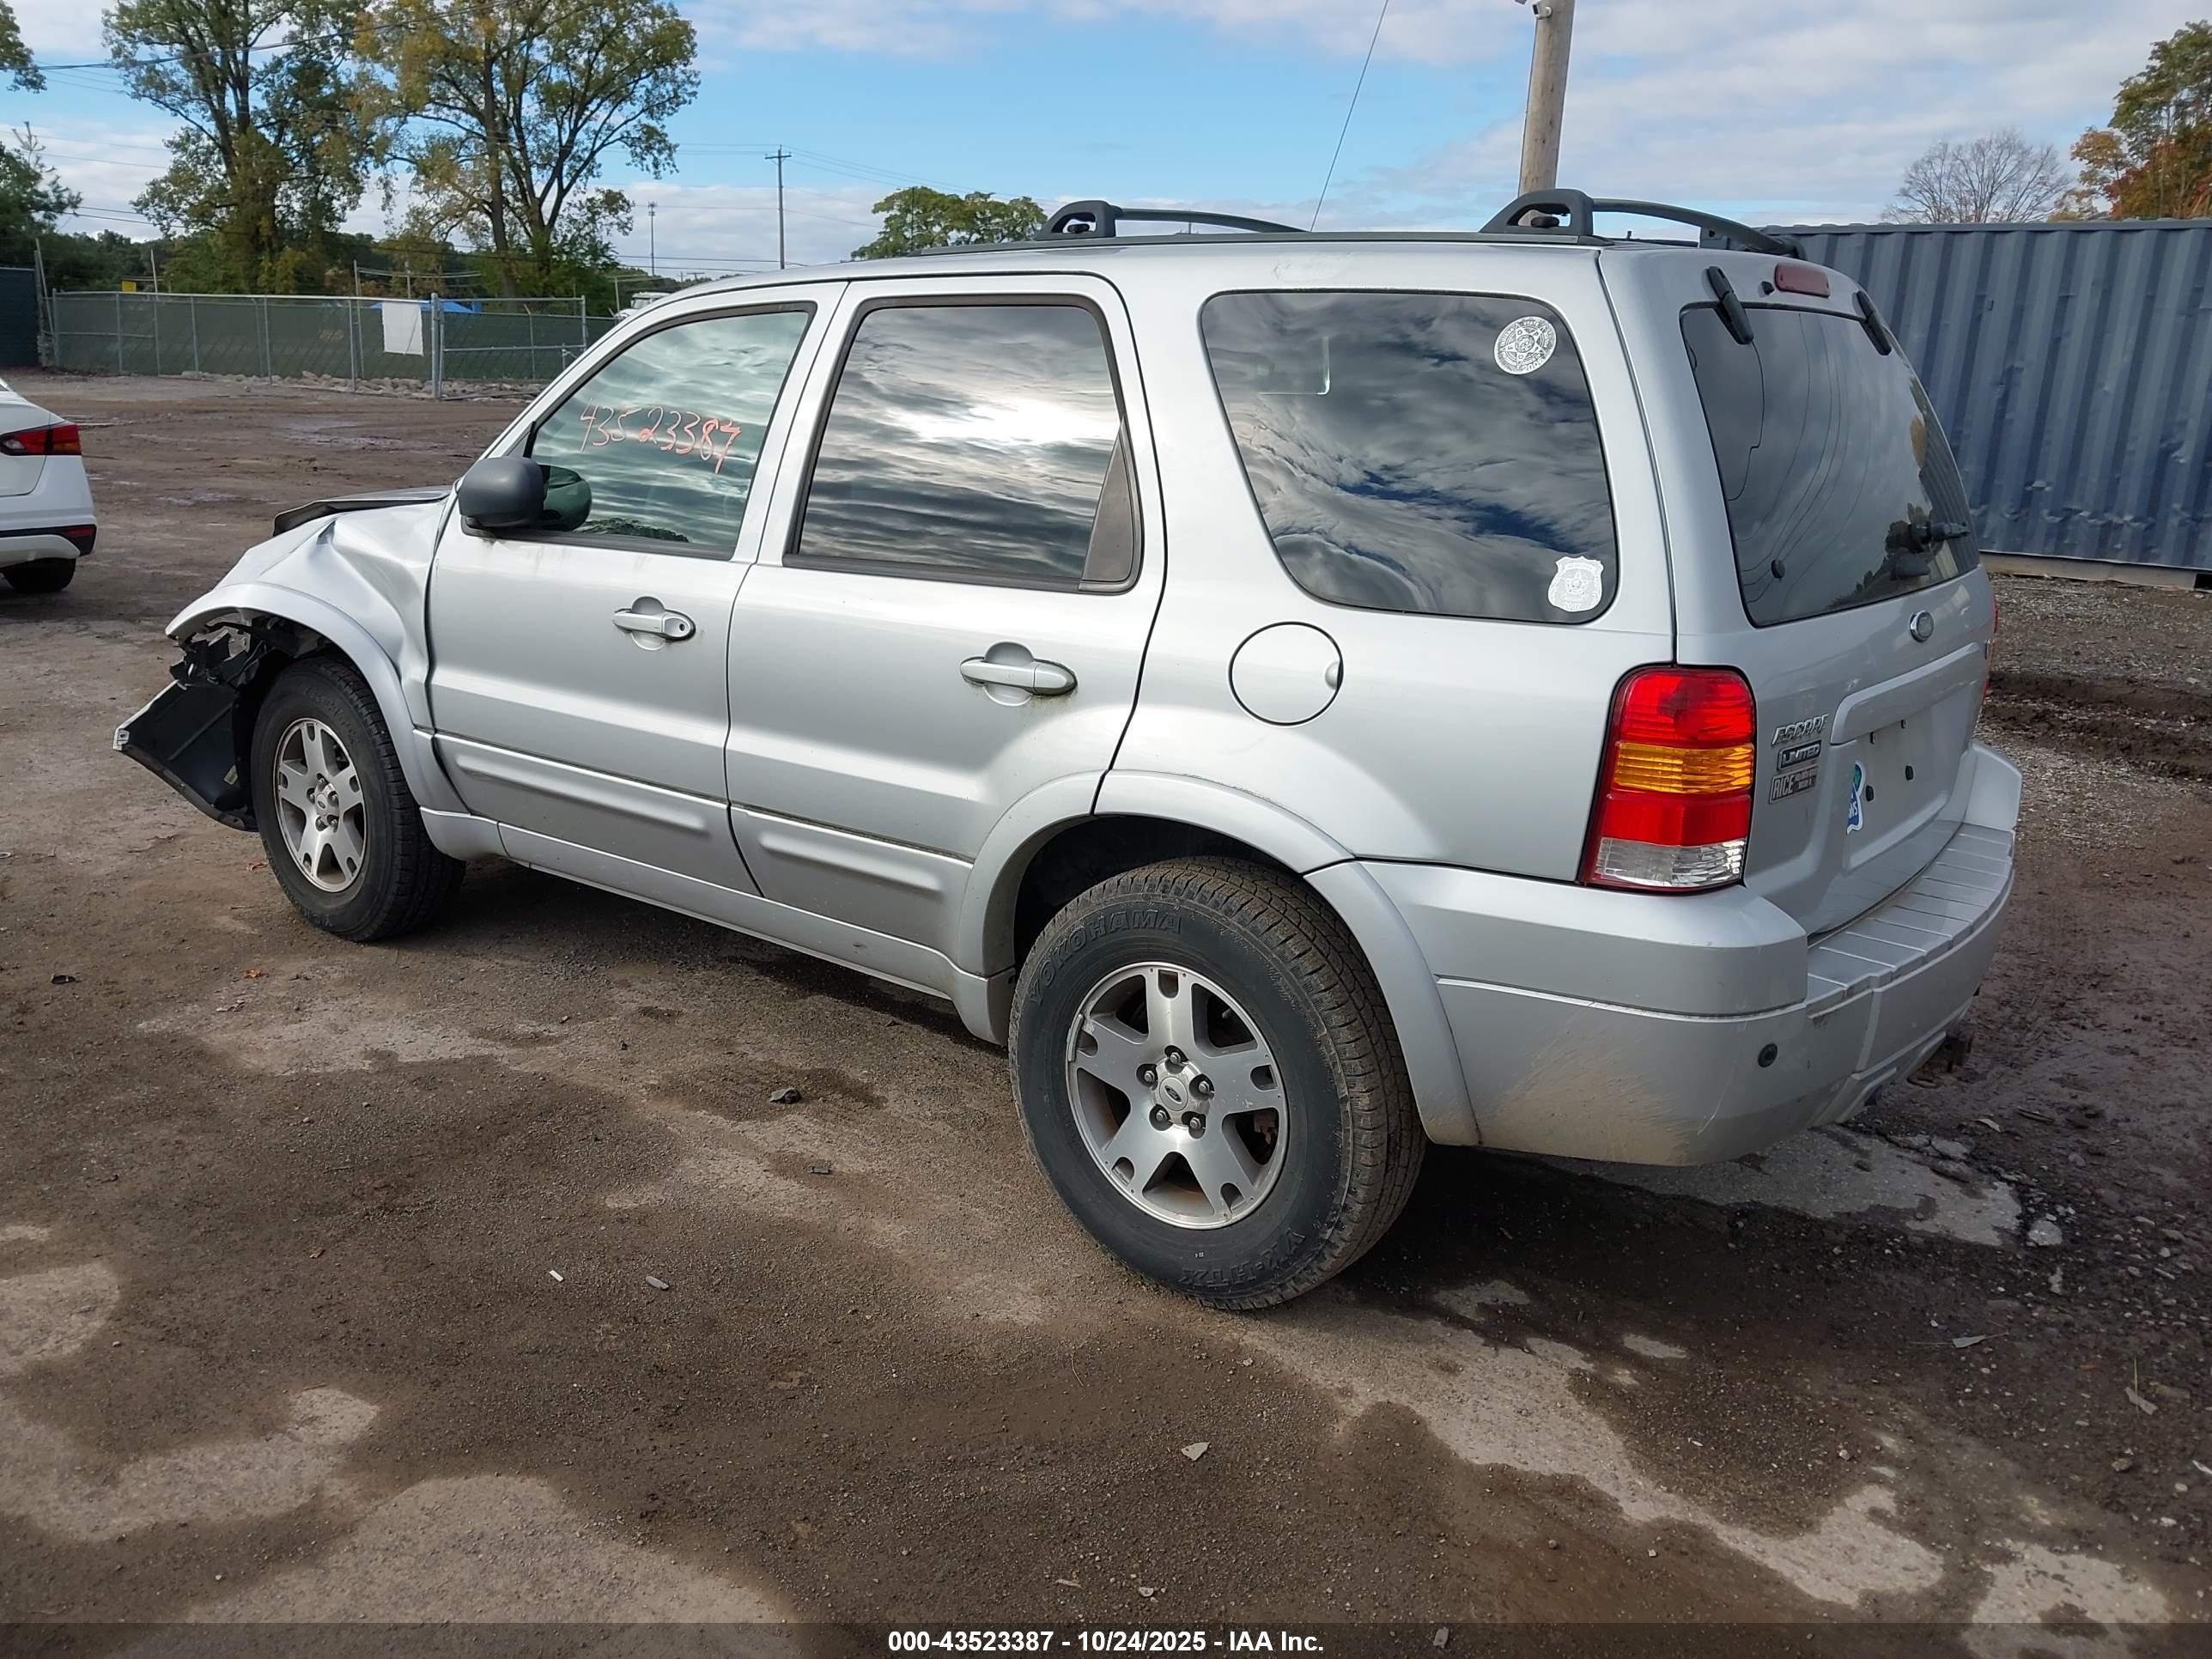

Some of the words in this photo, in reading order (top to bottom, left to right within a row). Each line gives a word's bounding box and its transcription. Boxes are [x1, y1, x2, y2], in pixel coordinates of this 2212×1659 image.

[580, 398, 741, 474] 43523387
[1772, 774, 1796, 799] RICE
[1030, 908, 1182, 1006] YOKOHAMA
